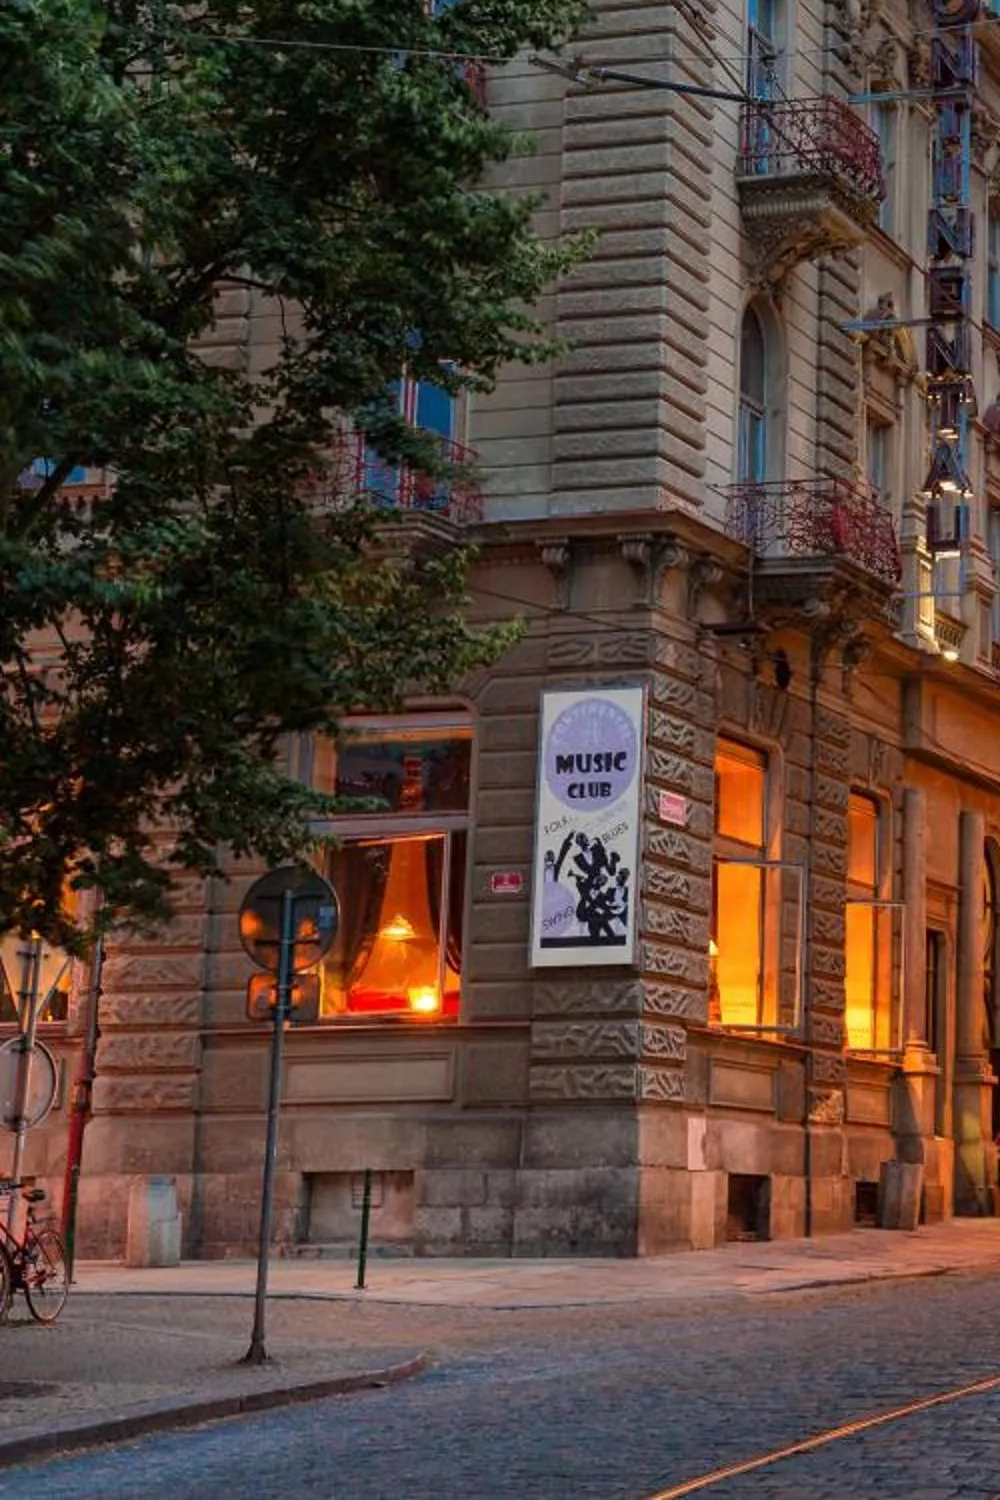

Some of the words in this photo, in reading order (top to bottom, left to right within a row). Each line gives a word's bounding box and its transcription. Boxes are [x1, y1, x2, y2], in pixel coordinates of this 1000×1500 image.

[555, 752, 627, 775] MUSIC
[567, 782, 612, 798] CLUB
[543, 904, 575, 931] SWING
